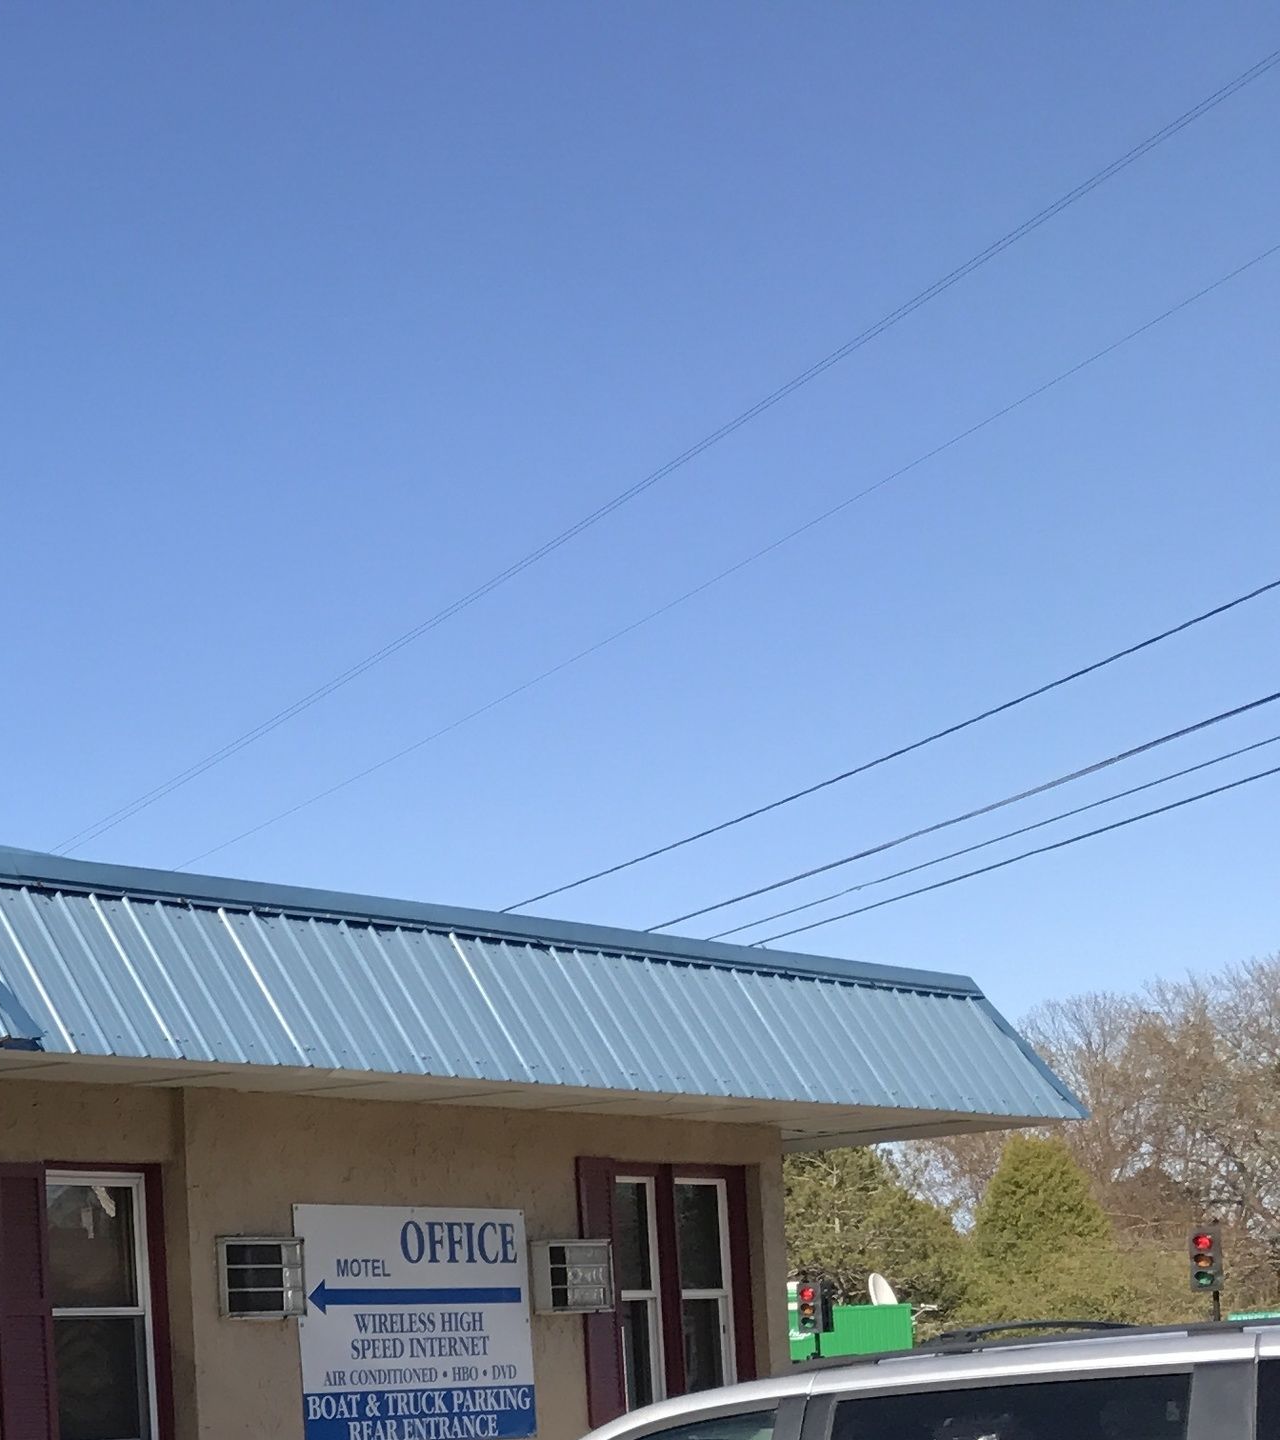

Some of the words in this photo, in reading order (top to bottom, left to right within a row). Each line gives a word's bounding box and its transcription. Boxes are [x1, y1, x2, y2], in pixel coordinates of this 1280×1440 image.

[400, 1220, 518, 1264] OFFICE
[336, 1258, 391, 1278] MOTEL
[353, 1312, 436, 1334] WIRELESS
[440, 1311, 485, 1333] HIGH
[350, 1337, 405, 1360] SPEED
[409, 1335, 490, 1358] INTERNET
[323, 1370, 347, 1387] AIR
[349, 1366, 438, 1386] CONDITIONED
[452, 1366, 479, 1382] HBO
[492, 1364, 518, 1380] DVD
[306, 1394, 361, 1420] BOAT
[365, 1393, 381, 1417] &
[384, 1391, 448, 1415] TRUCK
[452, 1387, 532, 1413] PARKING
[403, 1414, 499, 1440] ENTRANCE
